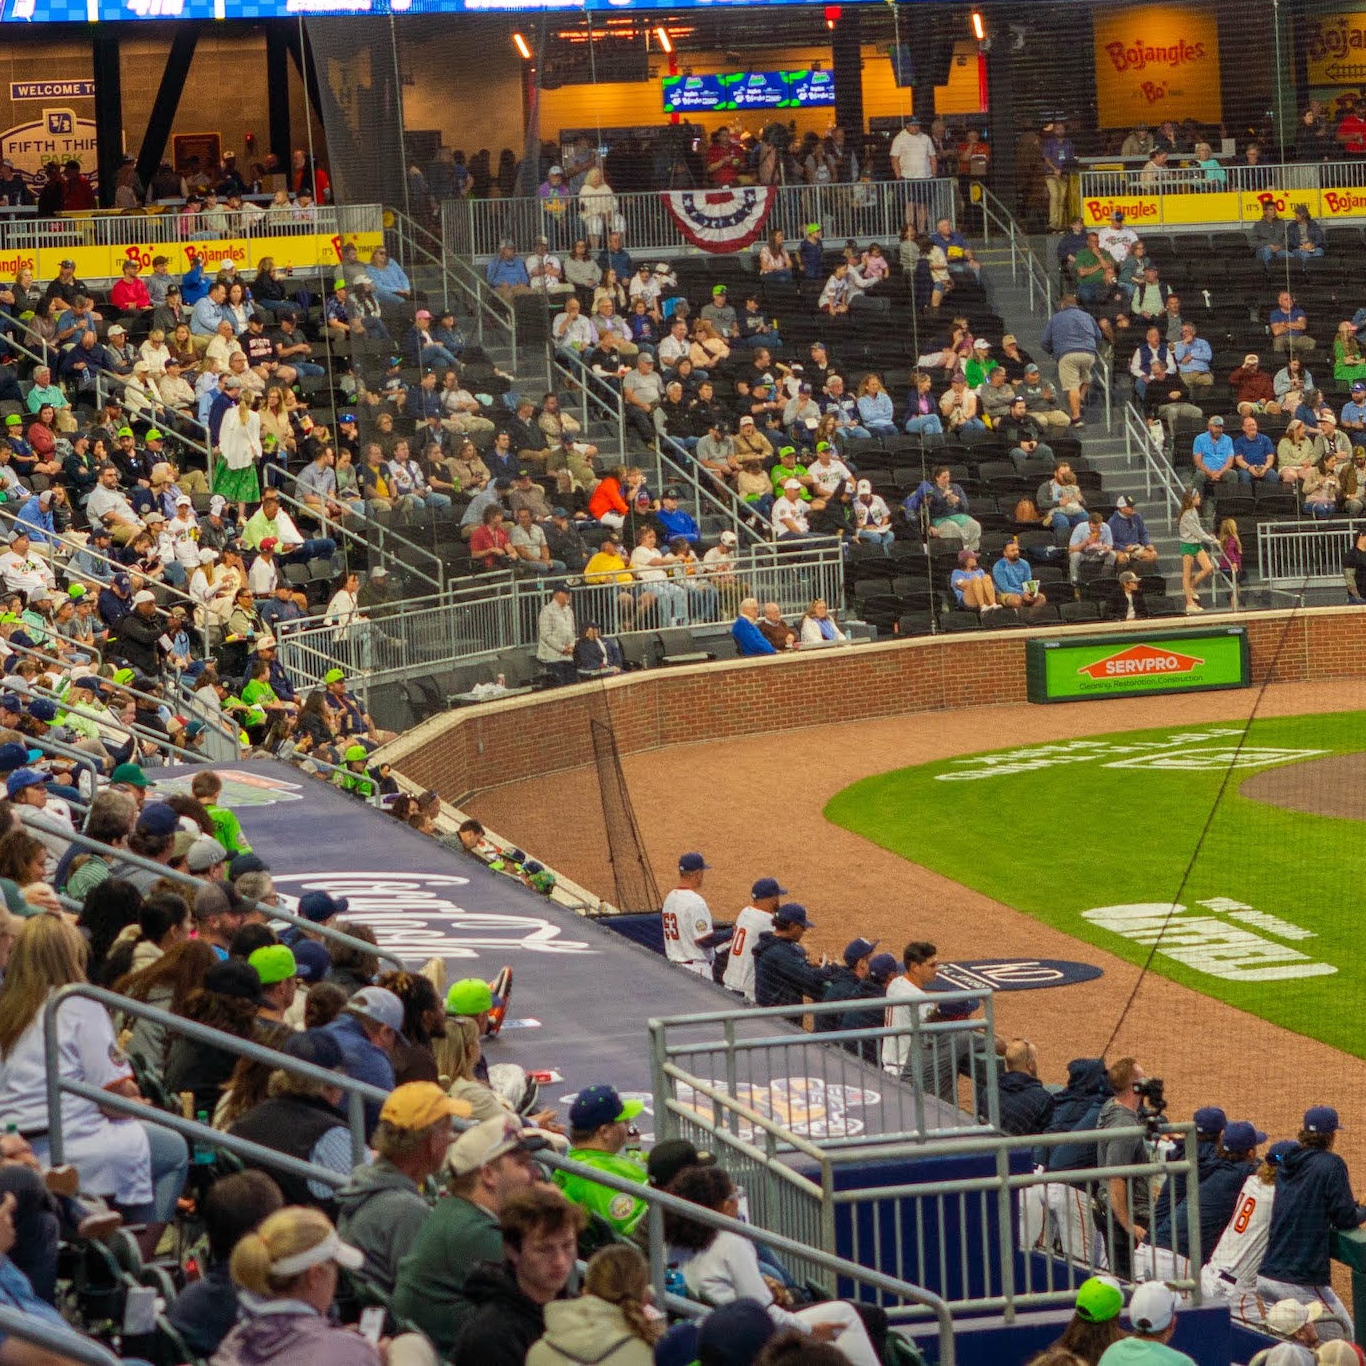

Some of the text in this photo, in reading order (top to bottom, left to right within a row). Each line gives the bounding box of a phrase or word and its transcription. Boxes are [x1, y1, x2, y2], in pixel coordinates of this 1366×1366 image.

[1105, 39, 1205, 72] Bojangles
[18, 84, 81, 96] WELCOME
[1140, 81, 1164, 105] Bo
[8, 140, 55, 153] FIFTH
[40, 153, 83, 166] PARK
[1087, 196, 1157, 222] Bojangles
[1246, 202, 1259, 211] IT'S
[125, 245, 151, 272] Bo
[184, 244, 246, 271] Bojangles
